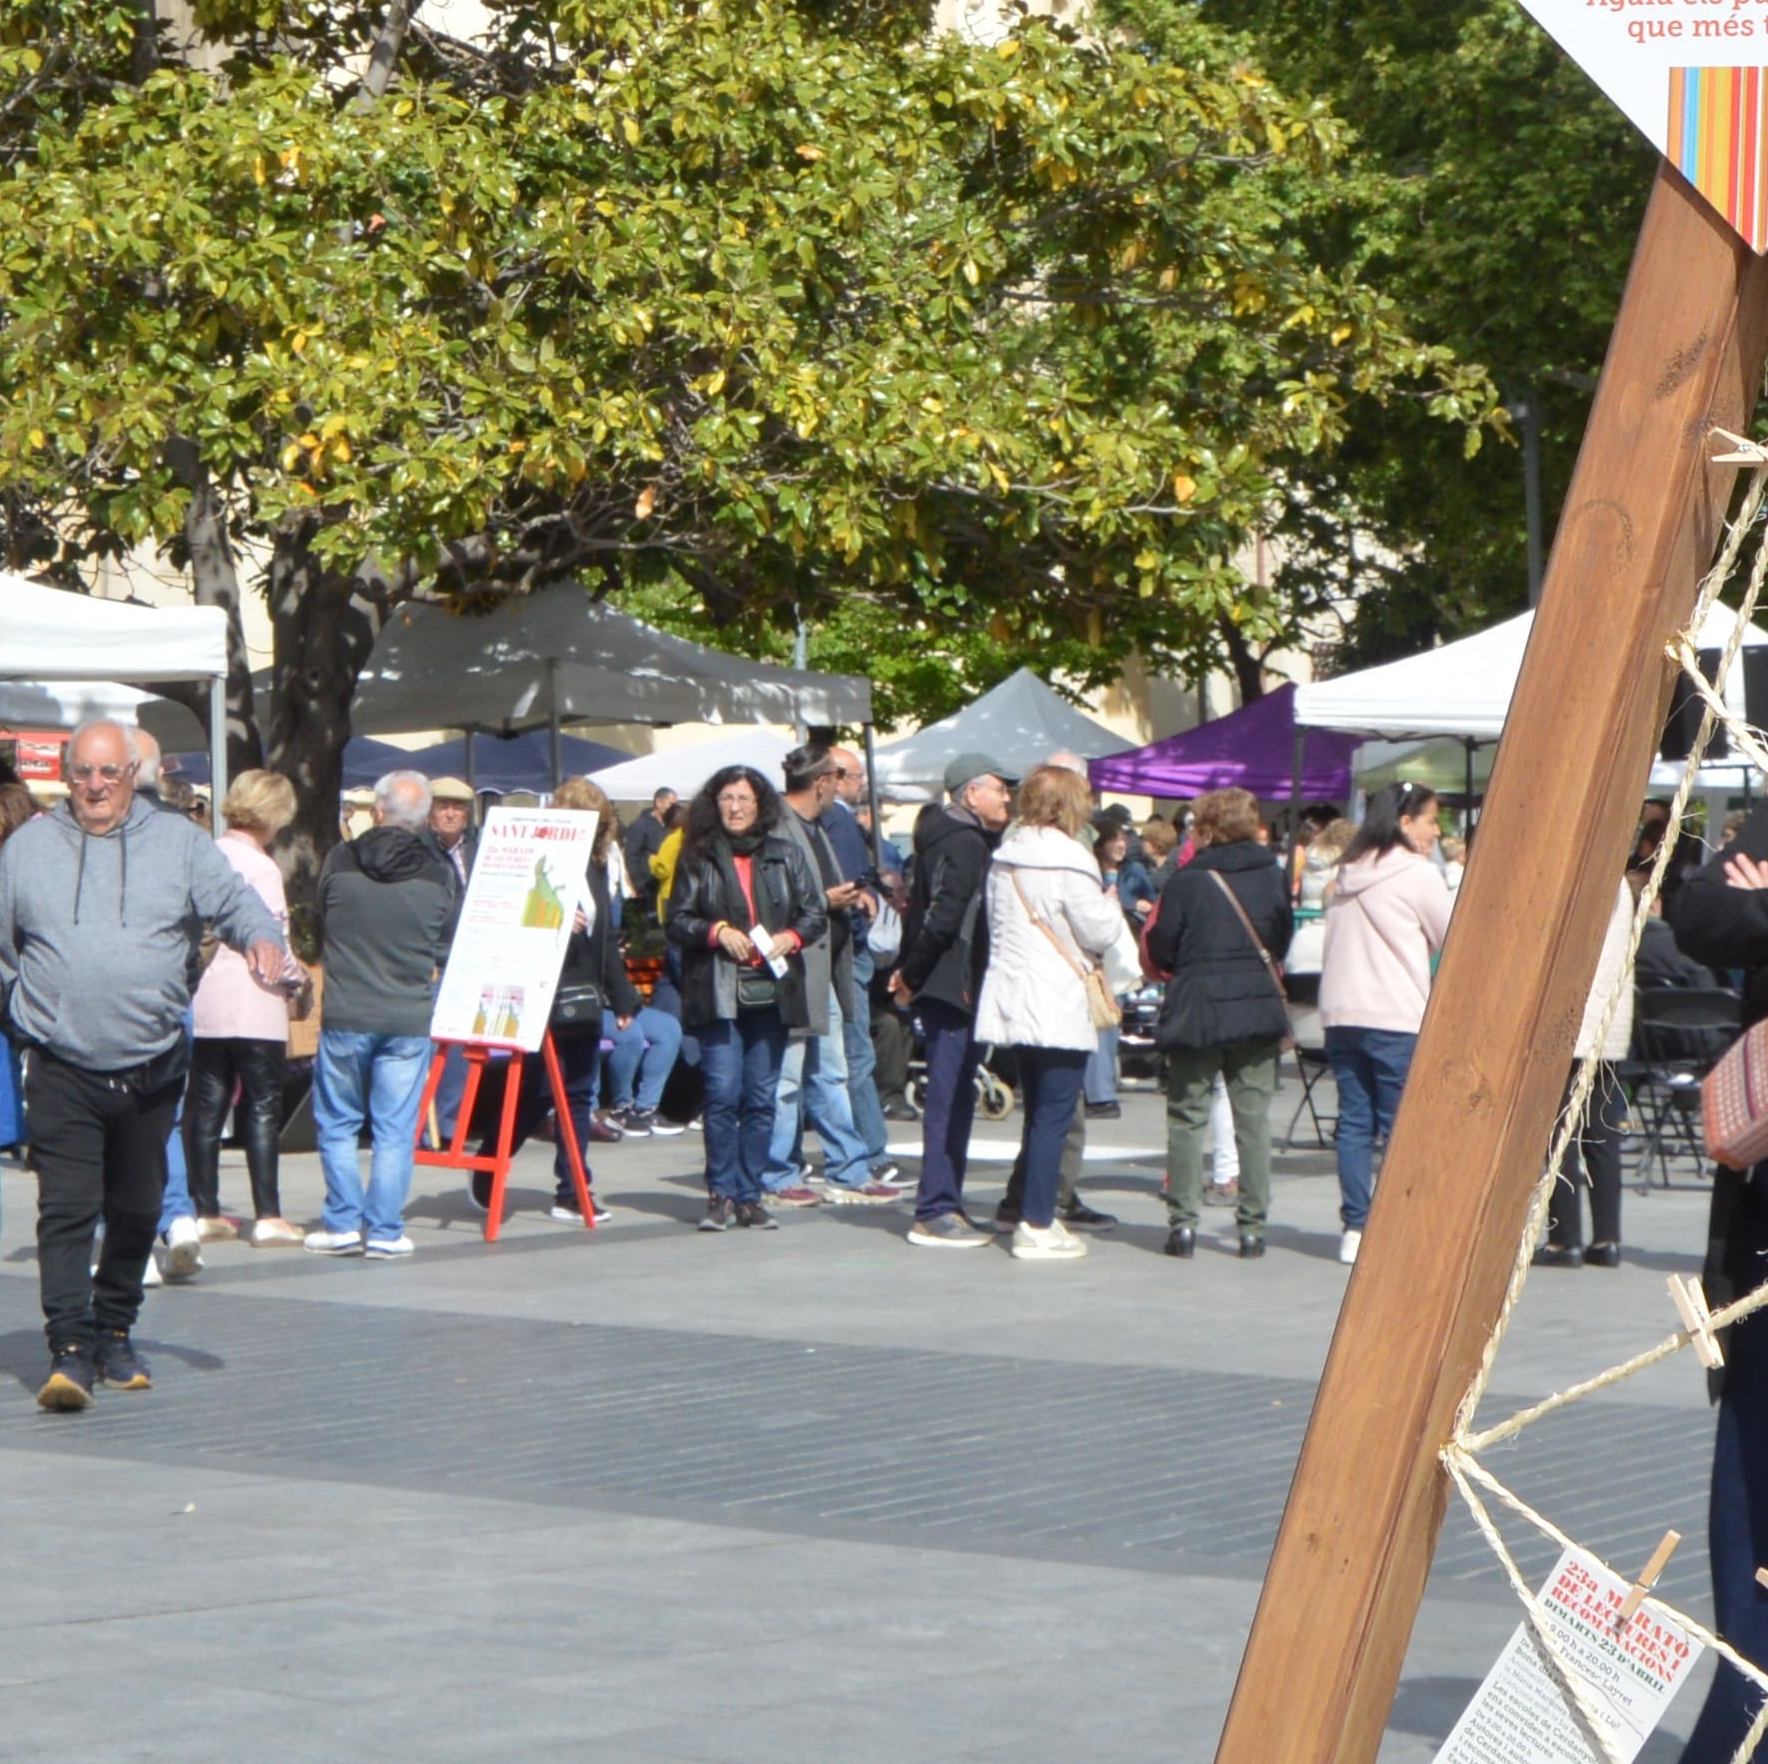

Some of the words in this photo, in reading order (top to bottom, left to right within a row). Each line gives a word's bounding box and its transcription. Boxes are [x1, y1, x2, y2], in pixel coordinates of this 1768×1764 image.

[1628, 21, 1682, 43] que
[1694, 15, 1753, 37] més
[1565, 1561, 1598, 1592] 23a
[1544, 1599, 1598, 1643] DIMARTS
[1599, 1638, 1616, 1656] 23
[1618, 1654, 1665, 1693] D'ABRIL
[1551, 1587, 1673, 1683] RECOMANACIONS
[1558, 1575, 1581, 1598] DE
[1671, 1659, 1681, 1671] I
[1486, 1690, 1503, 1705] ens
[1503, 1702, 1544, 1737] conviden
[1492, 1681, 1508, 1696] Les
[1509, 1693, 1540, 1720] escoles
[1540, 1717, 1552, 1729] de
[1603, 1680, 1633, 1706] Layret
[1463, 1725, 1476, 1738] de
[1469, 1717, 1503, 1746] Autores
[1481, 1698, 1495, 1711] les
[1493, 1710, 1518, 1731] seves
[1518, 1727, 1554, 1757] lectures
